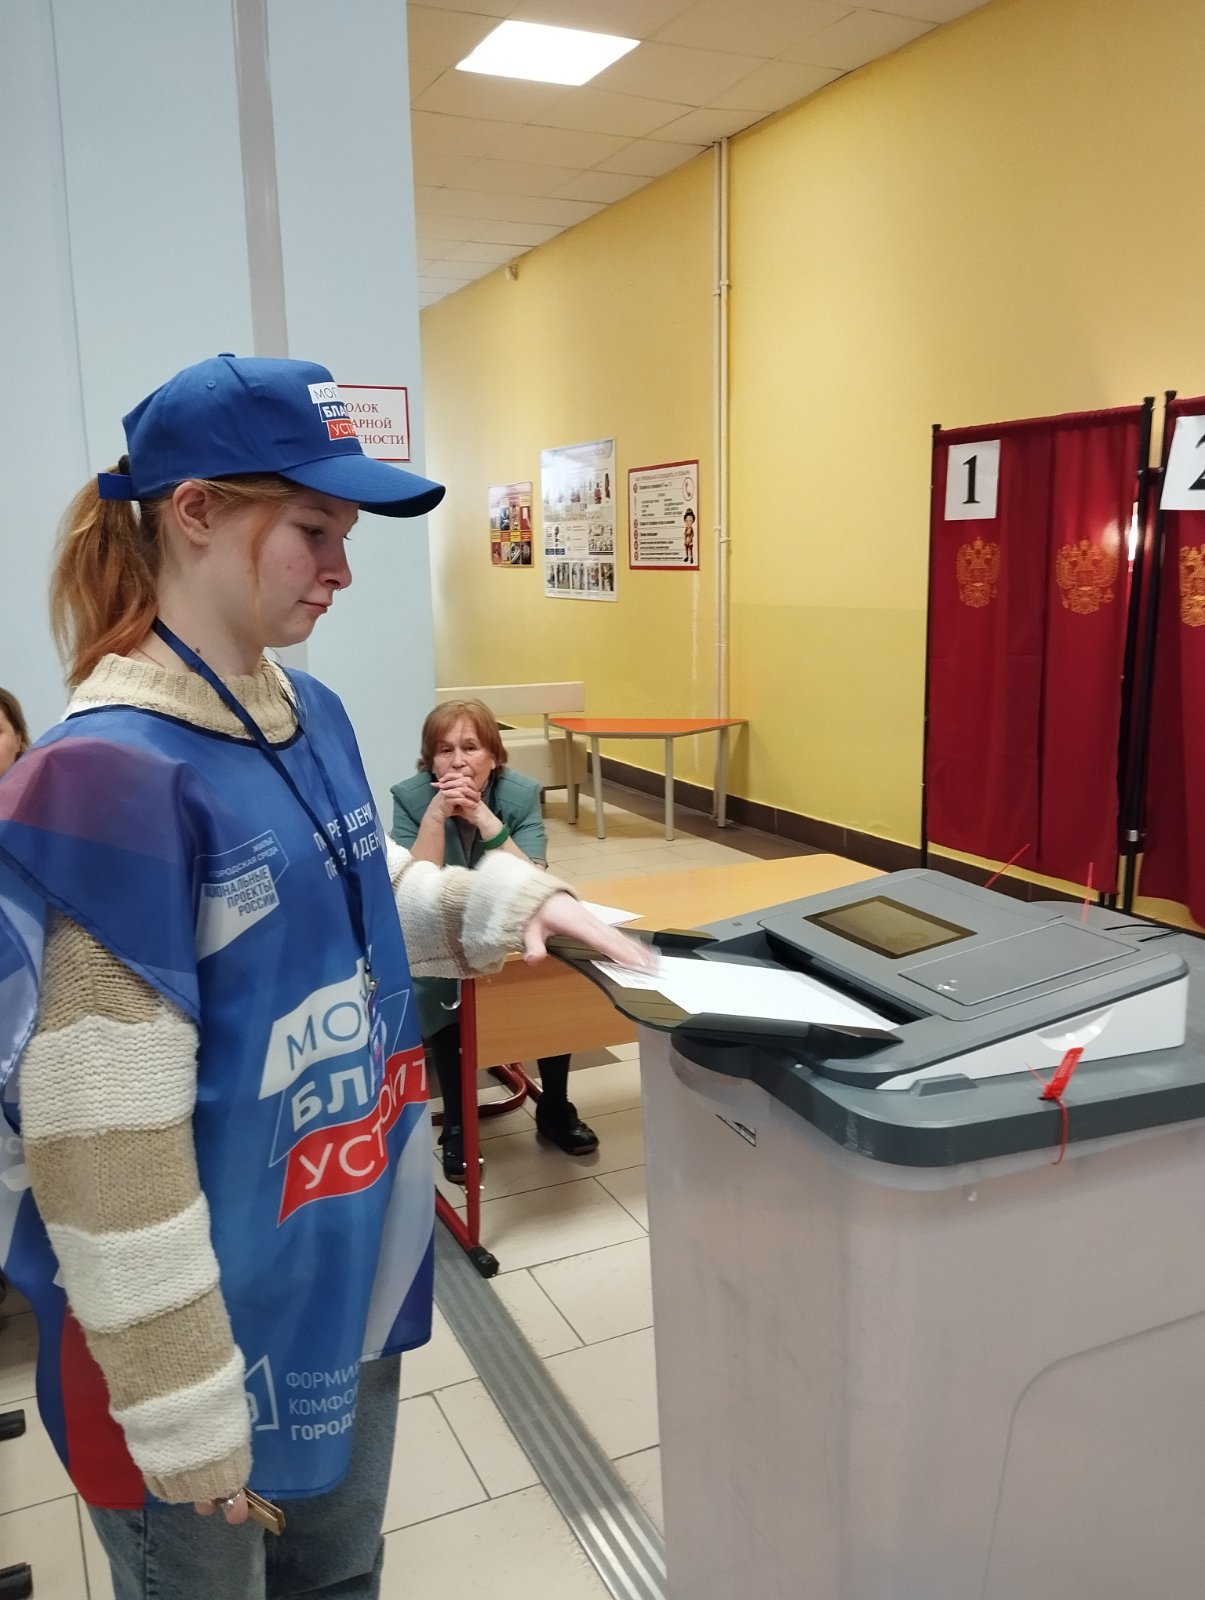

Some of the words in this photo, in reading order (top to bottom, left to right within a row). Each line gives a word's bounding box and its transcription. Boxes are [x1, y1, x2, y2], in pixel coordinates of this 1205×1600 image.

[345, 402, 379, 413] ОЛОК
[351, 417, 392, 429] АРНОЙ
[359, 434, 405, 445] СНОСТИ
[962, 454, 981, 505] 1
[227, 879, 273, 908] ПРОЕКТЫ
[238, 892, 277, 916] РОССИИ
[286, 1001, 363, 1071] МО
[291, 1065, 369, 1133] БЛ
